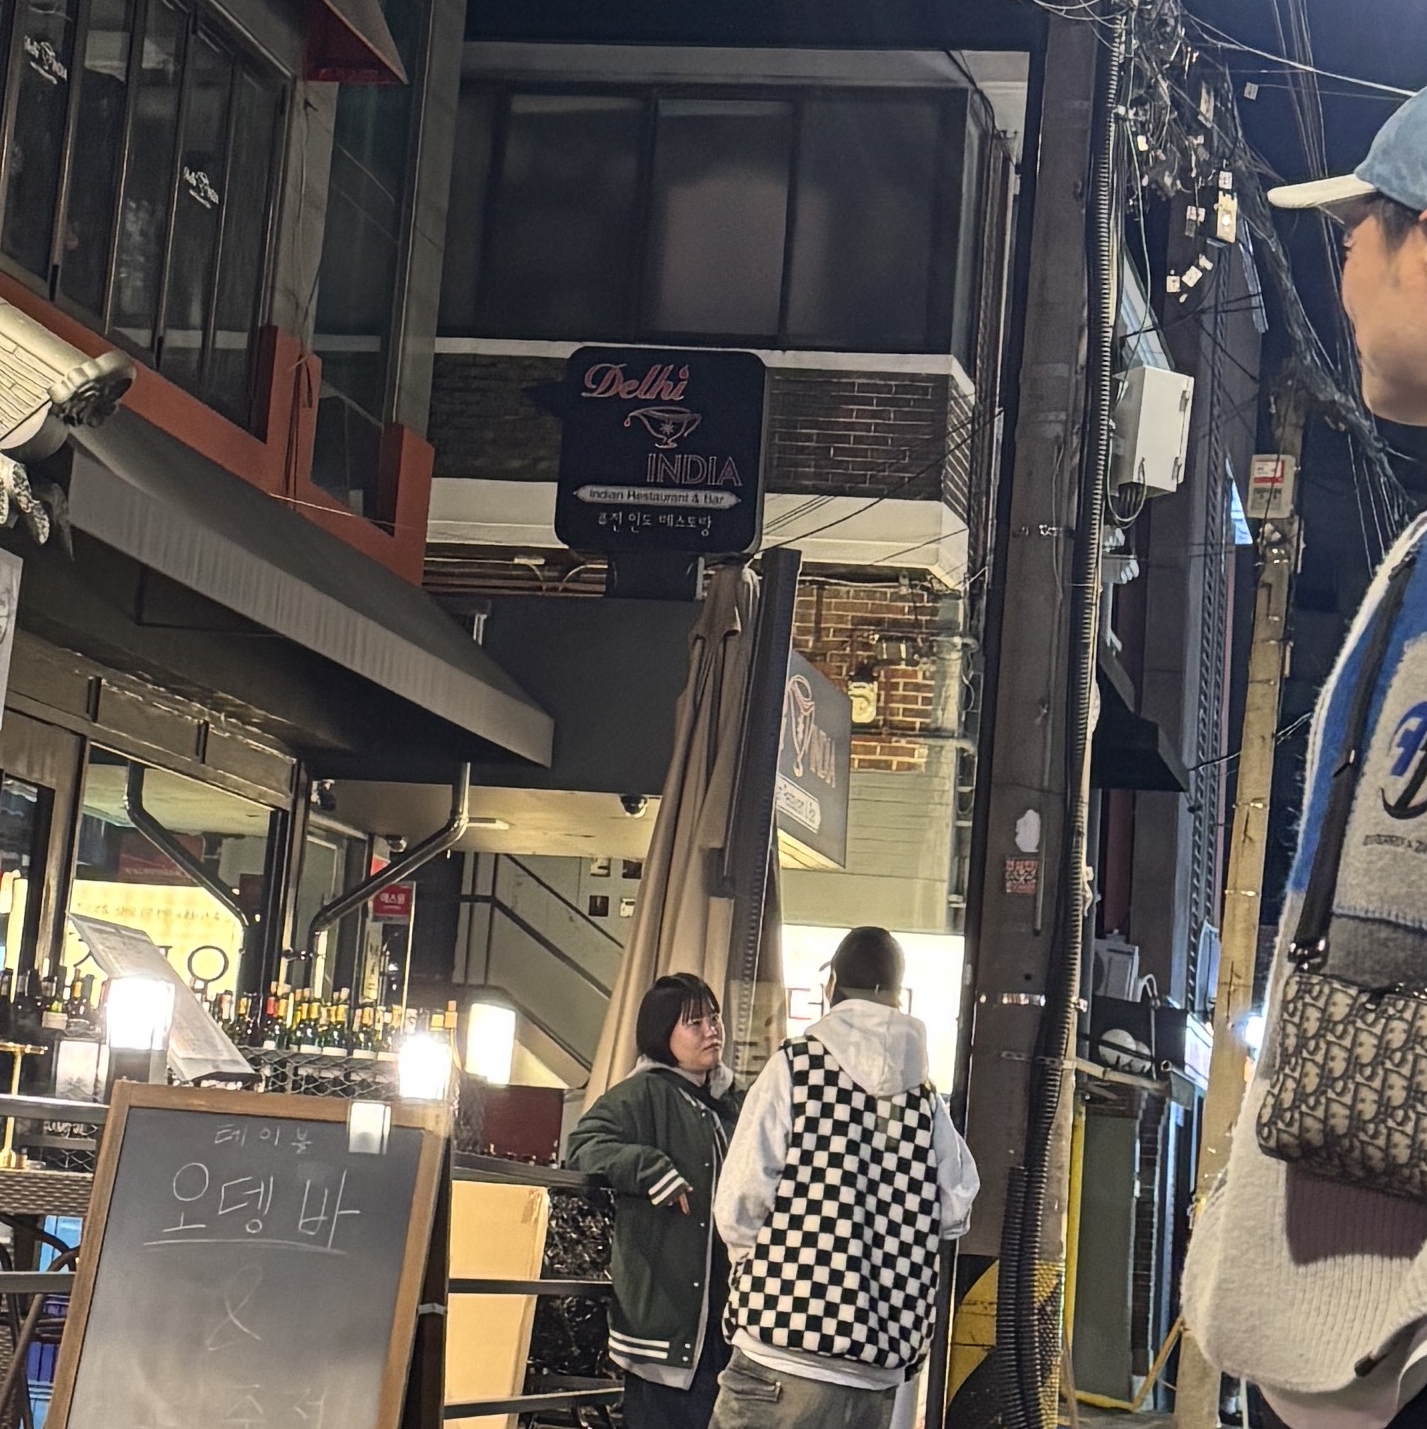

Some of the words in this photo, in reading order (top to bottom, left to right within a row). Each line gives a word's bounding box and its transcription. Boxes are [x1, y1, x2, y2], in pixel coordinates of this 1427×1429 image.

[581, 362, 691, 402] Delhi
[645, 452, 744, 488] INDIA
[588, 488, 625, 501] Indian
[628, 512, 653, 535] 인도
